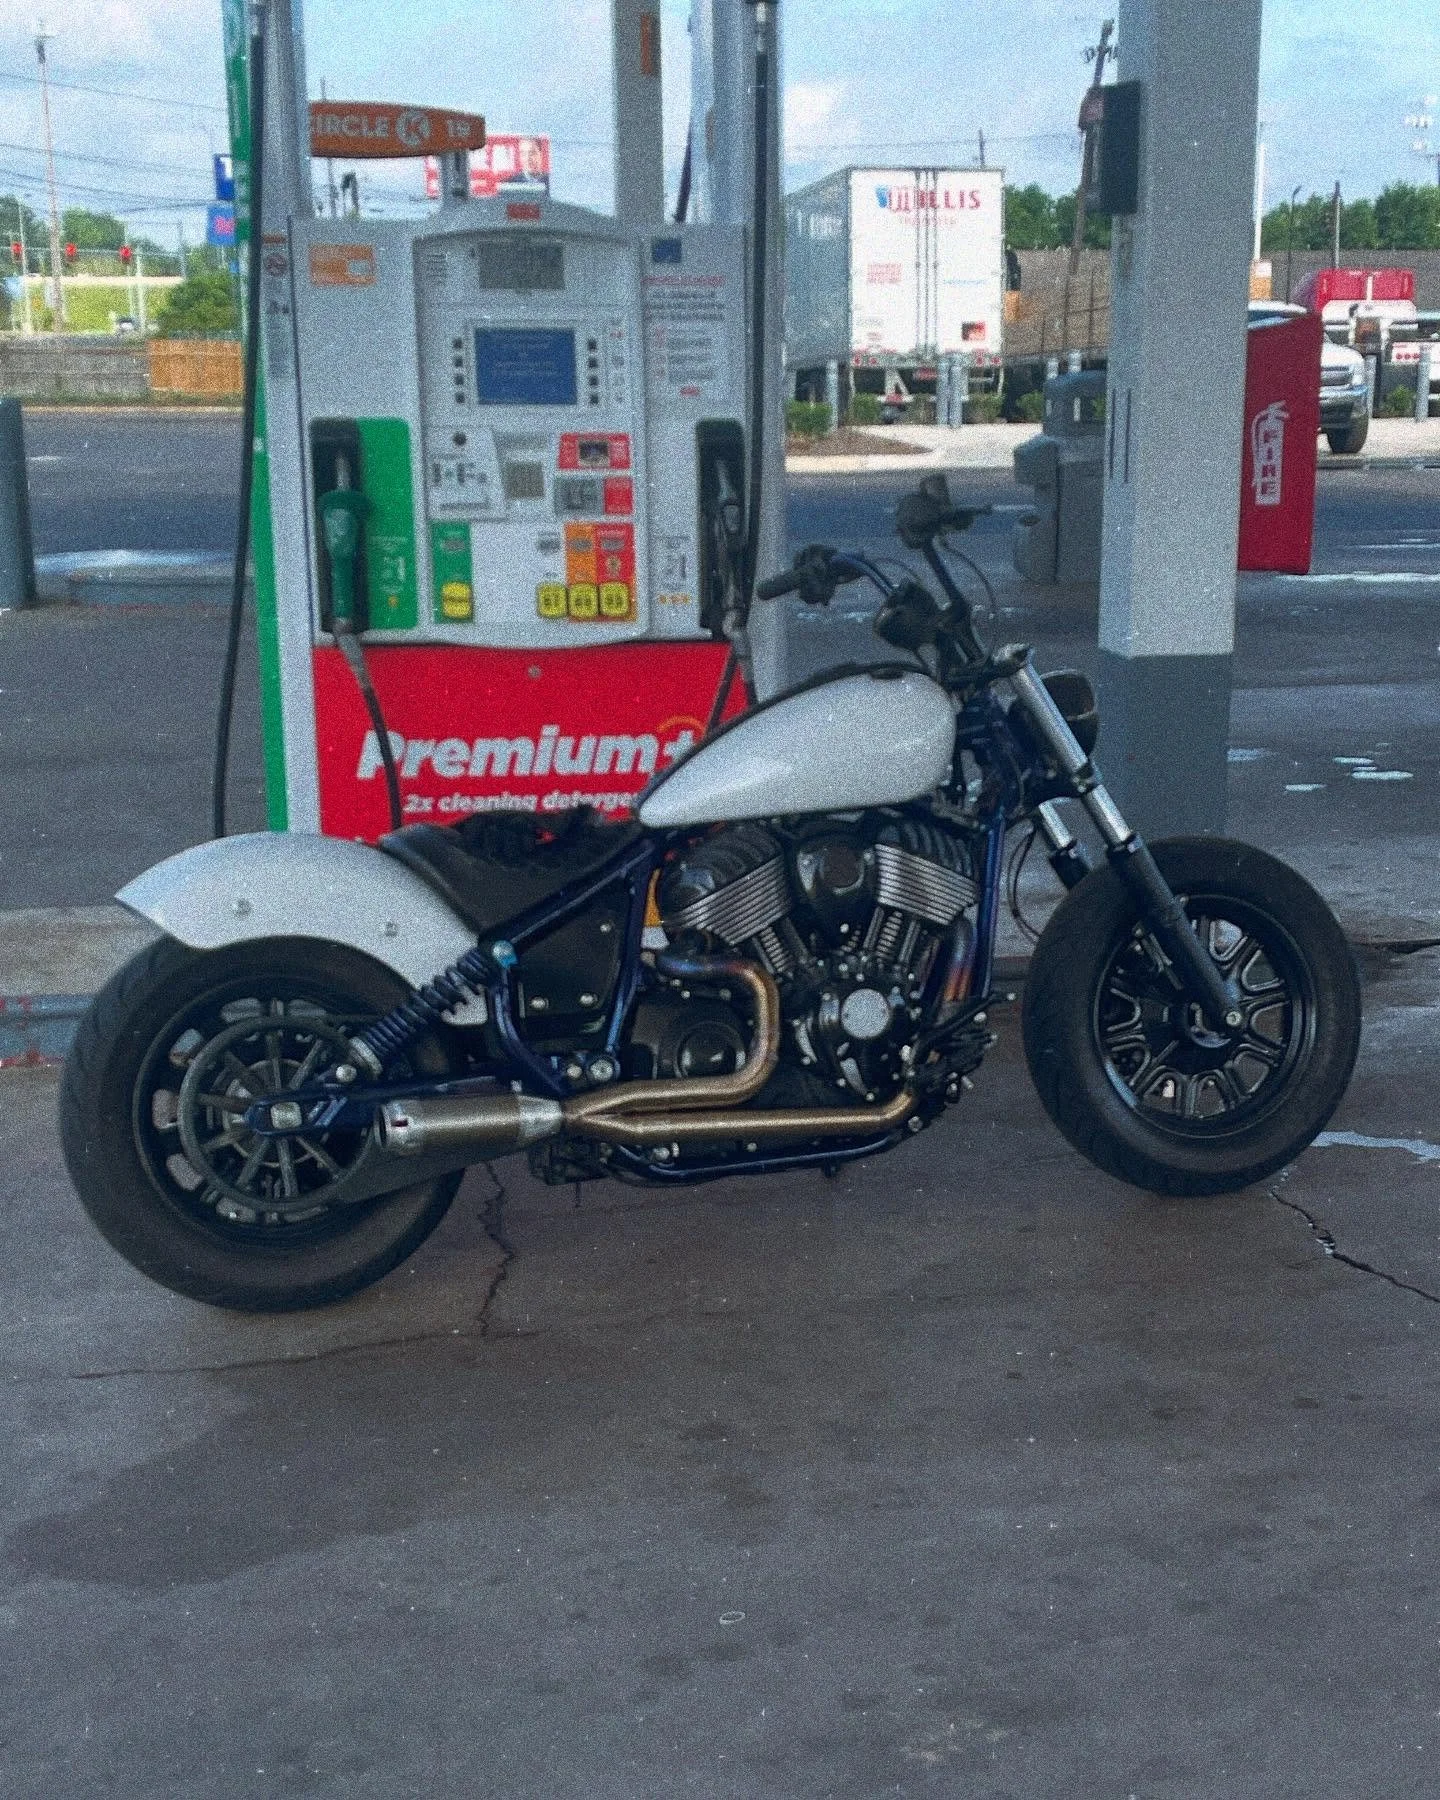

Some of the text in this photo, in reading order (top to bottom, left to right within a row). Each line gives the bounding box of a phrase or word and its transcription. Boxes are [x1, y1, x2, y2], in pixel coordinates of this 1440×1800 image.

[311, 114, 389, 137] IRCLE
[1260, 430, 1278, 495] FIRE
[403, 793, 433, 813] 2x
[438, 790, 537, 813] cleaning
